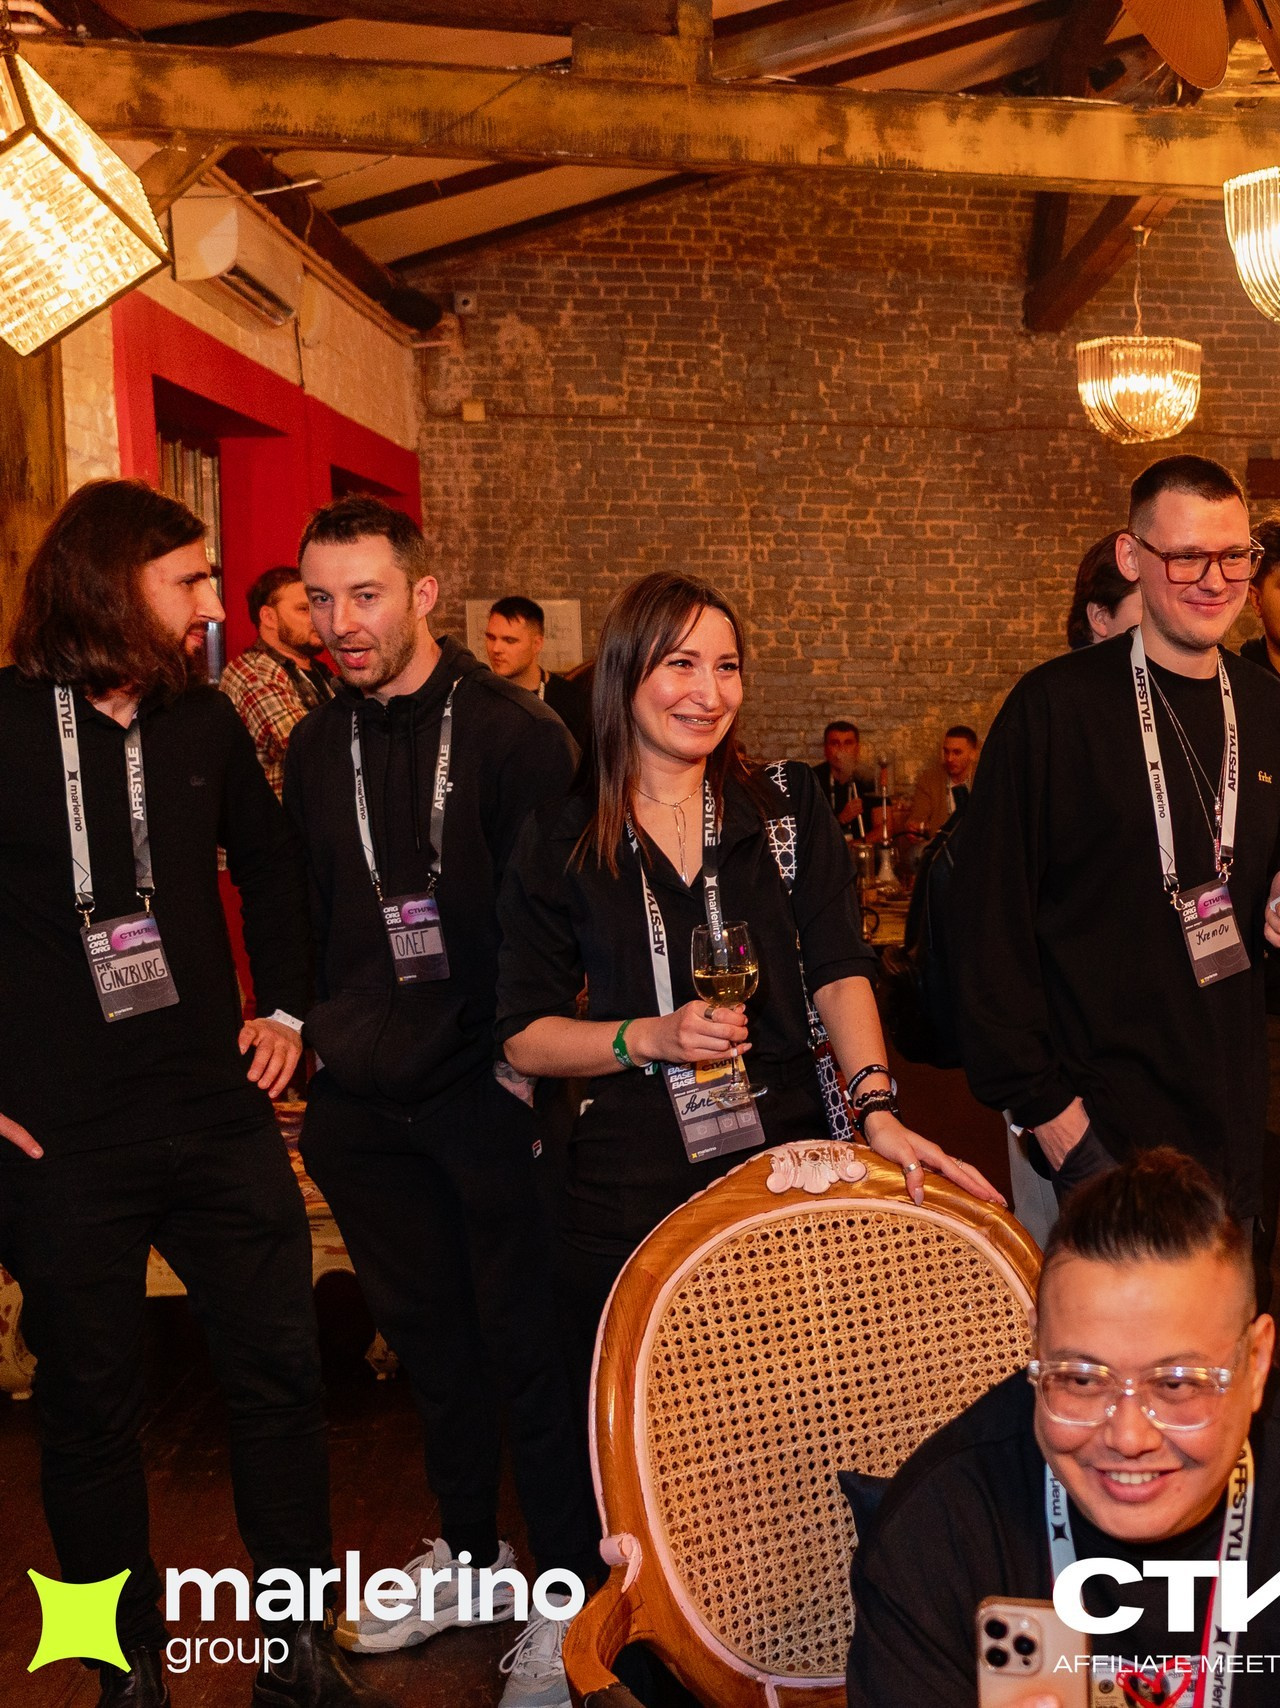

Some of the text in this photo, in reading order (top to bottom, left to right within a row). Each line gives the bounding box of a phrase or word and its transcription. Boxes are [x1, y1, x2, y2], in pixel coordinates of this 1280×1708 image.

[1134, 666, 1153, 733] AFFSTYLE
[1227, 723, 1236, 792] AFFSTYLE
[128, 747, 145, 821] AFFSTYLE
[434, 744, 450, 811] AFFSTYLE
[70, 785, 83, 832] marlerino
[1153, 773, 1166, 818] marlerino
[707, 890, 722, 941] marlerino
[1183, 906, 1196, 917] ORG
[1184, 912, 1198, 923] ORG
[87, 932, 107, 942] ORG
[89, 939, 110, 949] ORG
[91, 945, 111, 955] ORG
[100, 958, 166, 991] GINZBURG
[670, 1070, 694, 1083] BASE
[672, 1077, 696, 1090] BASE
